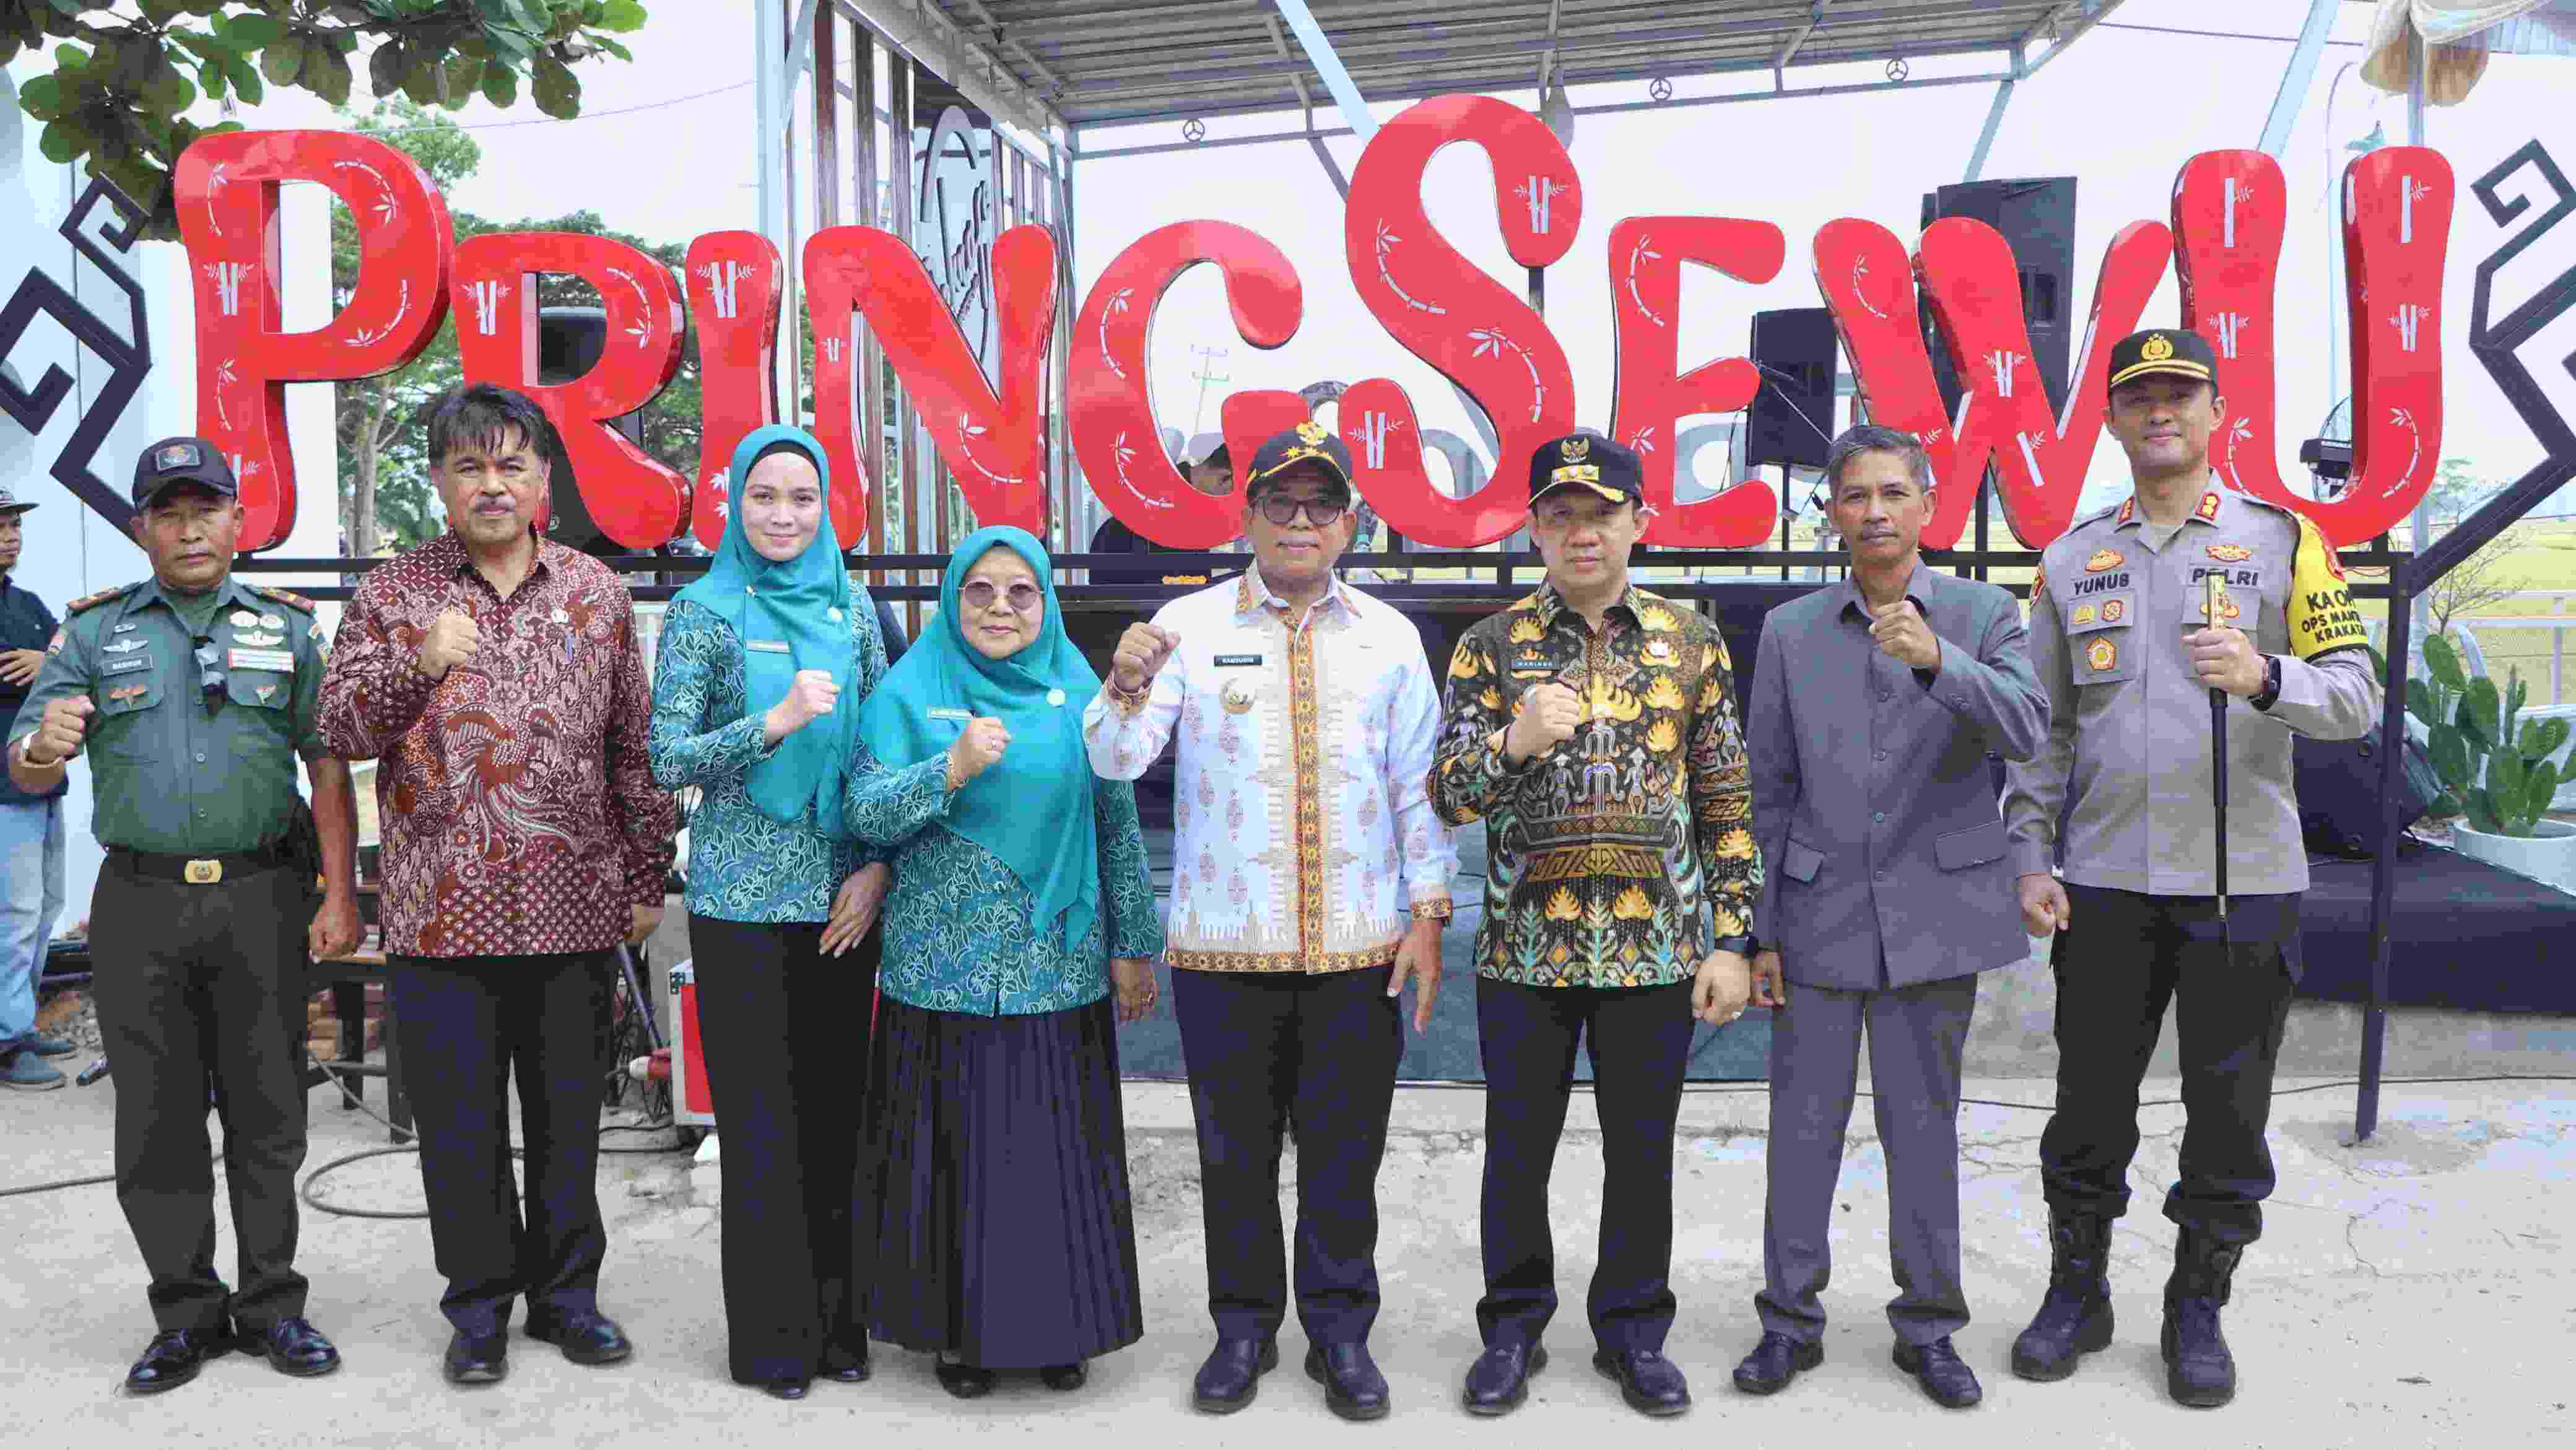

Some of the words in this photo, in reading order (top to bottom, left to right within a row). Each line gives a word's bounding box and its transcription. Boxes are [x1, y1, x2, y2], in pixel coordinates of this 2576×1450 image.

[2074, 573, 2130, 595] YUNUS
[2192, 567, 2259, 586] PLRI
[2302, 614, 2328, 632] OPS
